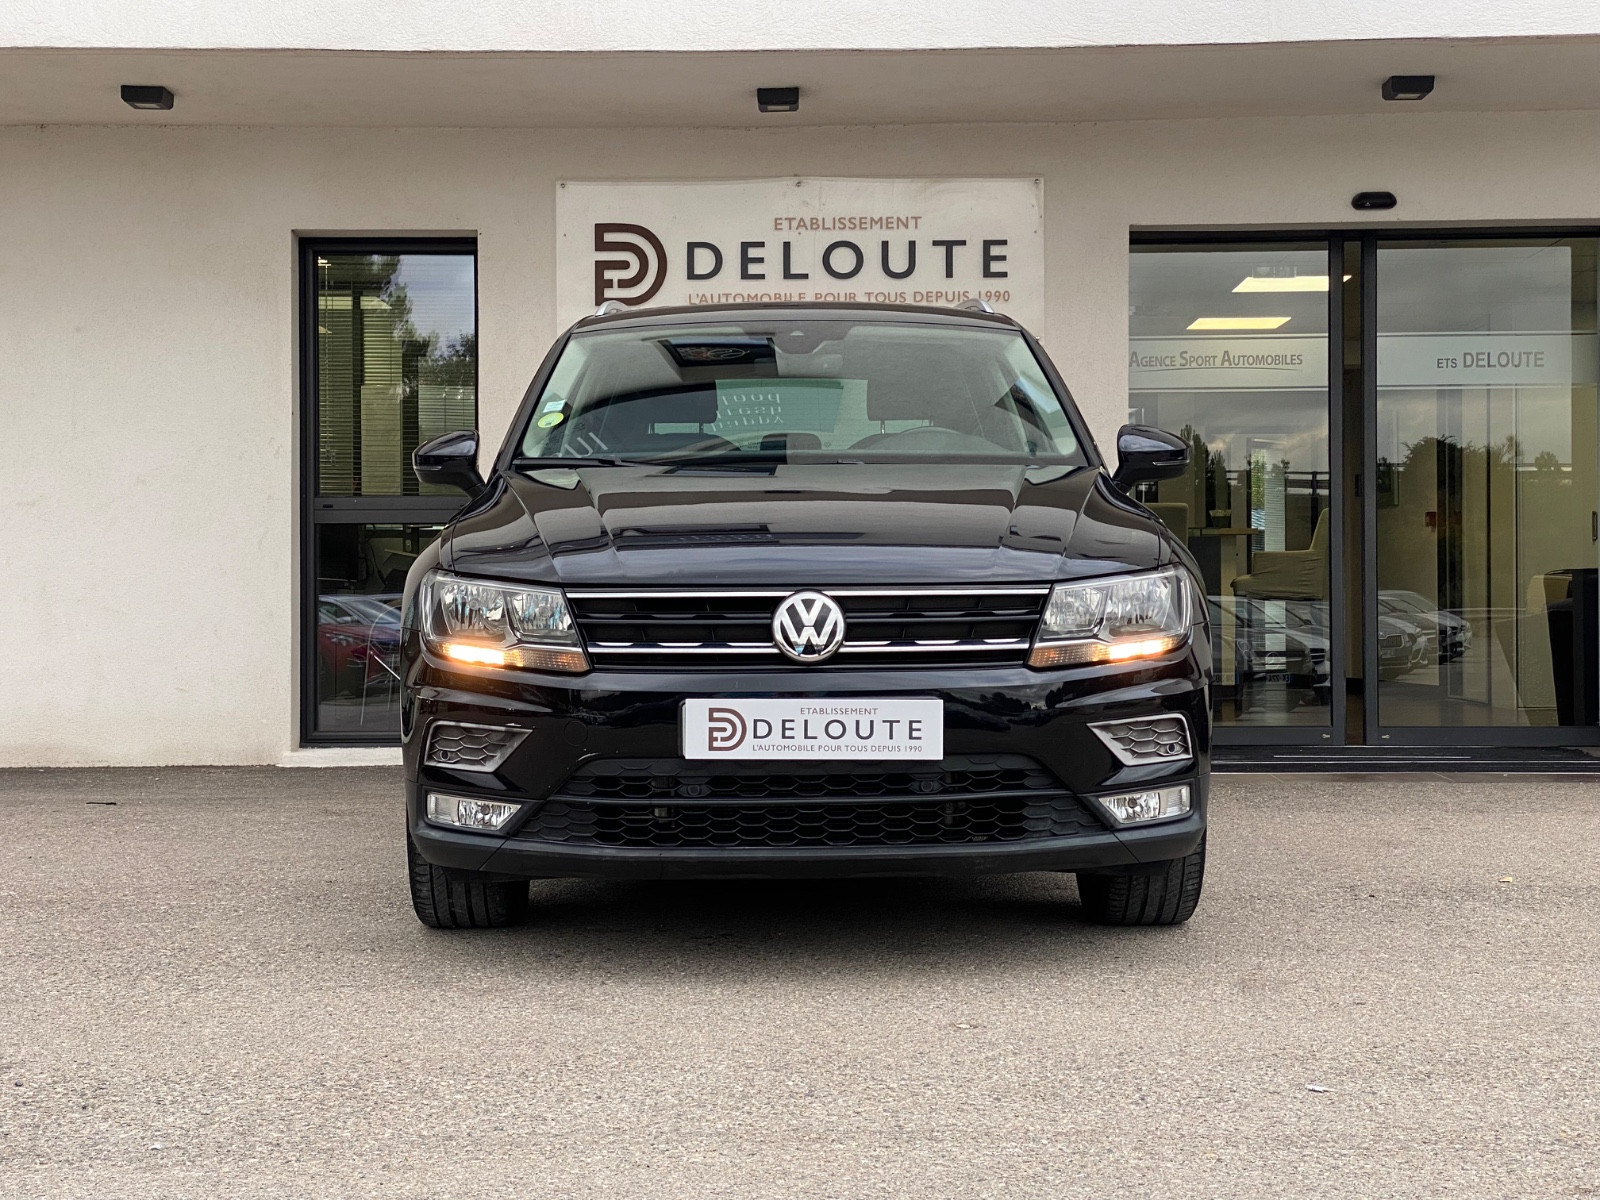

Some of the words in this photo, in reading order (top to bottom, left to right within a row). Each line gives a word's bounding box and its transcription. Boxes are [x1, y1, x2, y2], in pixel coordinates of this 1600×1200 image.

[773, 215, 922, 232] ETABLISSEMENT
[686, 239, 1009, 281] DELOUTE
[814, 292, 857, 302] POUR
[864, 291, 907, 303] TOUS
[913, 290, 970, 303] DEPUIS
[978, 290, 1011, 302] 1990
[1436, 358, 1458, 369] ETS
[1462, 351, 1545, 368] DELOUTE
[800, 707, 878, 715] ETABLISSEMENT
[752, 718, 923, 741] DELOUTE
[752, 744, 815, 752] L'AUTOMOBILE
[818, 744, 842, 752] POUR
[845, 744, 868, 752] TOUS
[870, 744, 901, 752] DEPUIS
